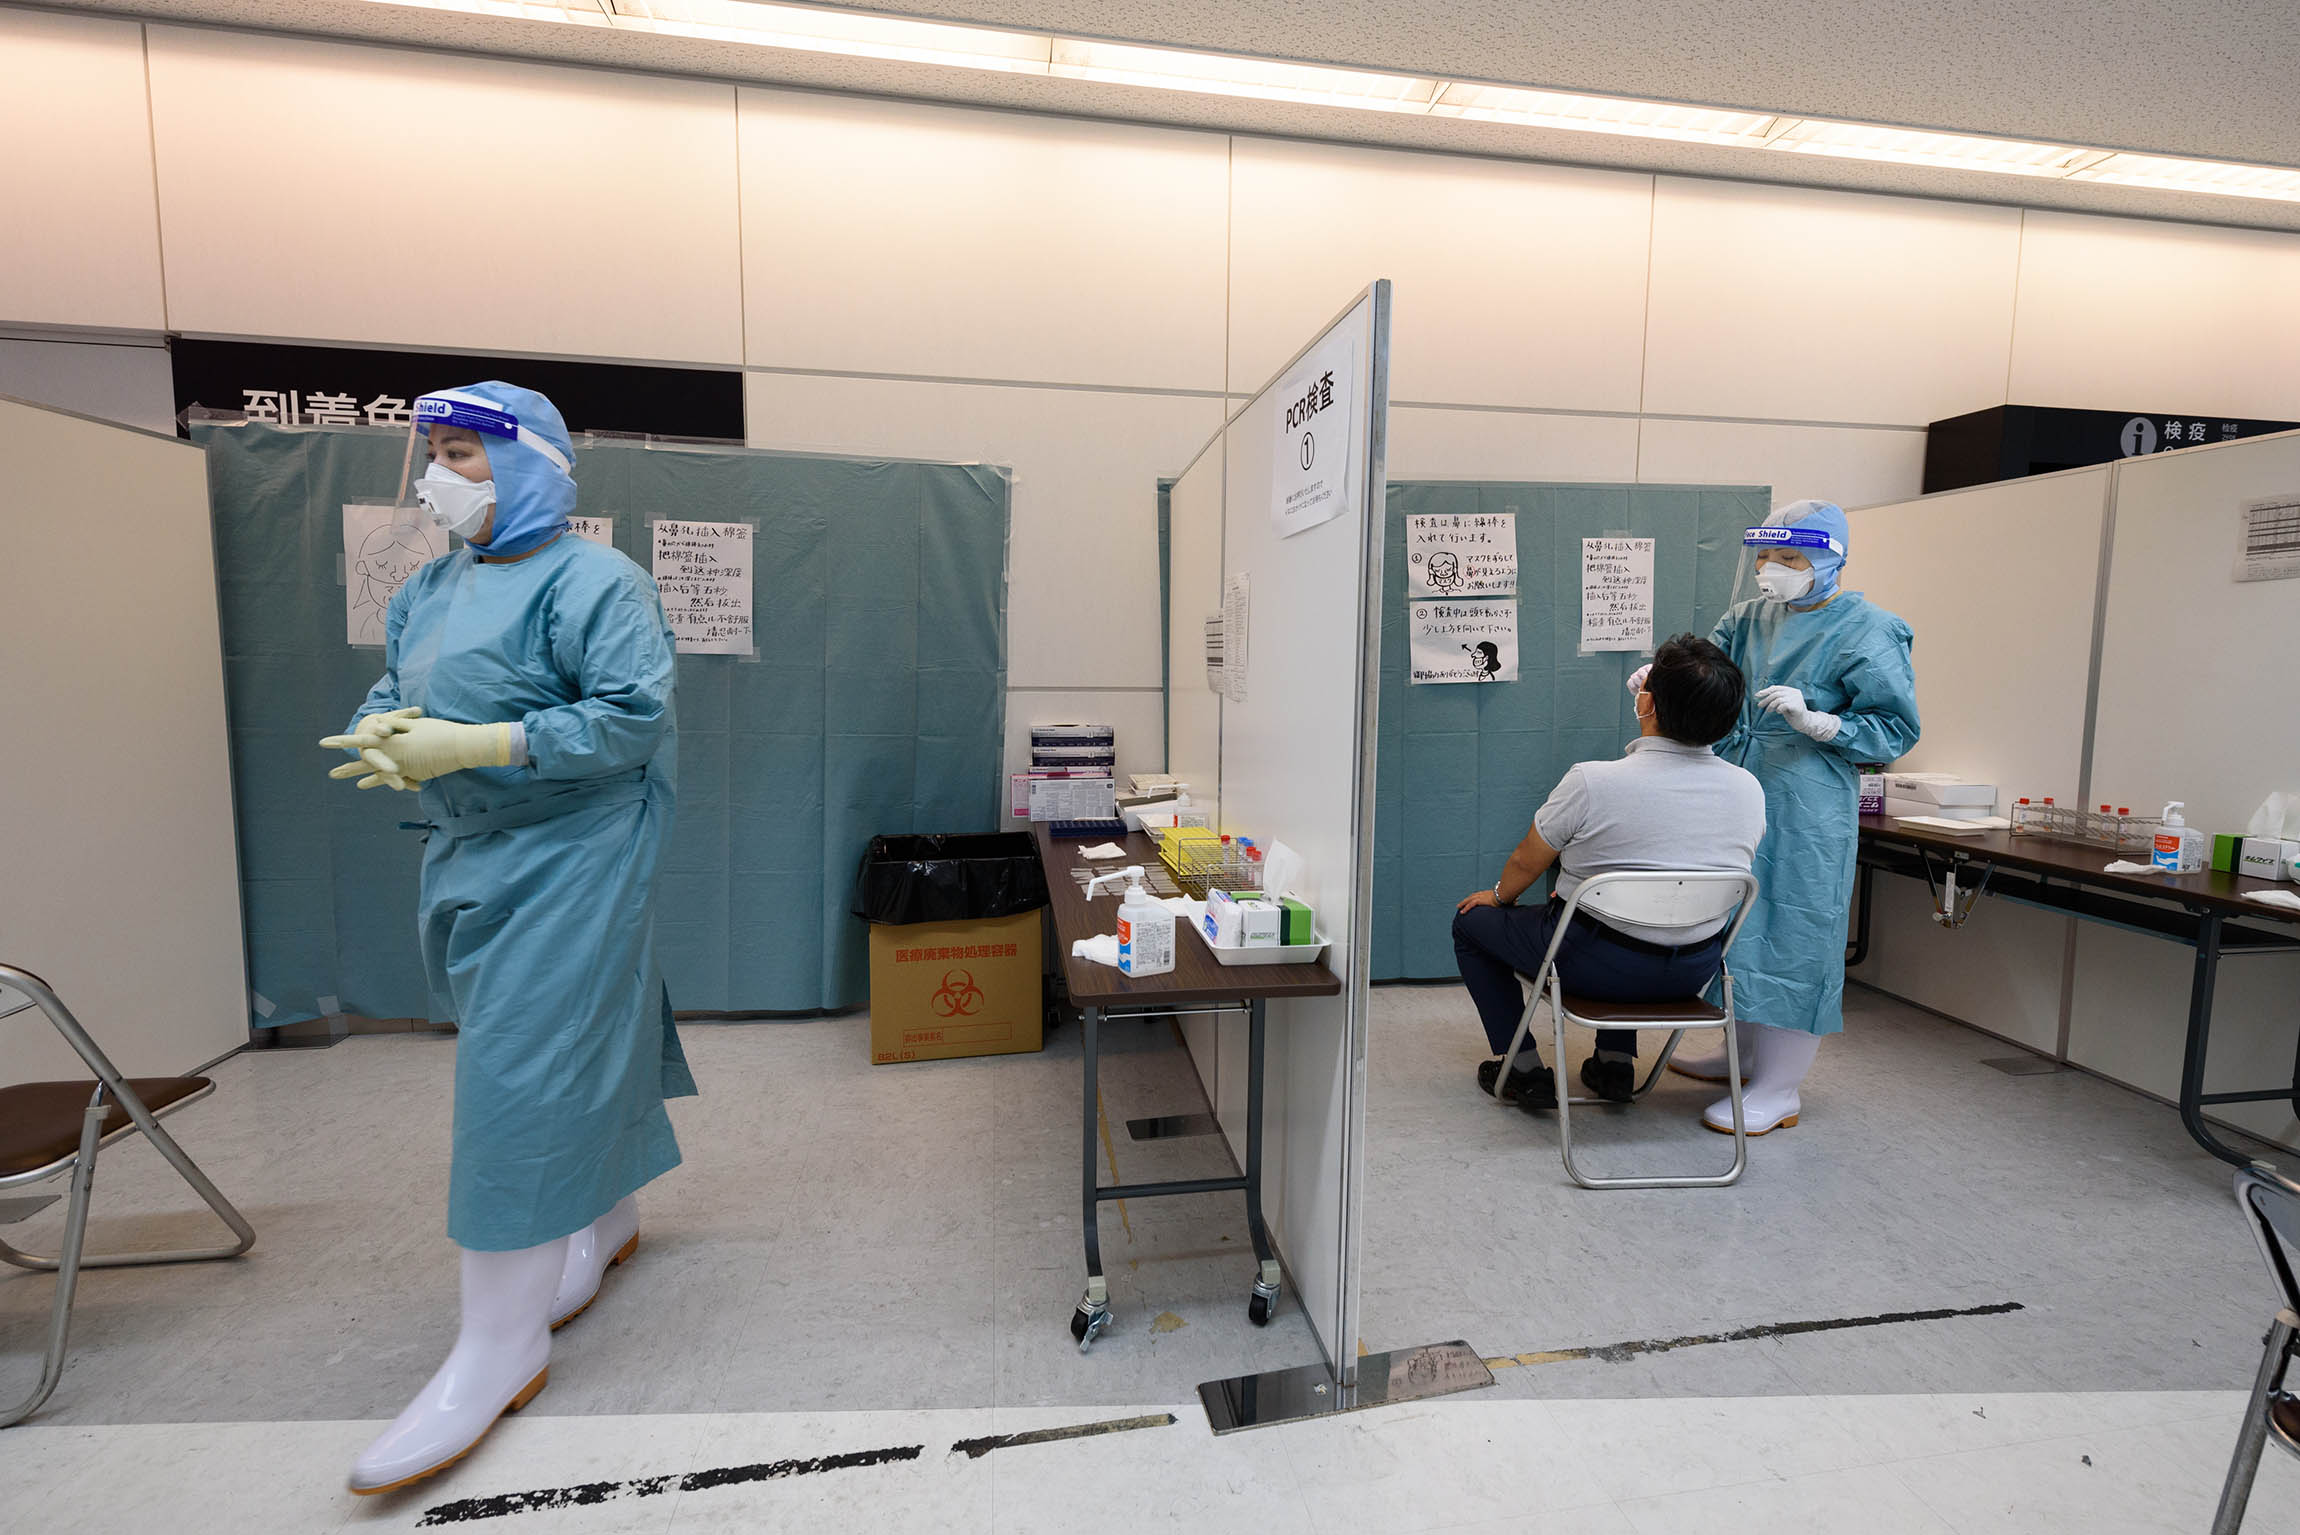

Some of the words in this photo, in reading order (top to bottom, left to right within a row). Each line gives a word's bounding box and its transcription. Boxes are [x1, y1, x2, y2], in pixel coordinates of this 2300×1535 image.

[1286, 370, 1334, 434] PCR検査
[2164, 421, 2206, 441] 検疫
[1416, 532, 1492, 544] 入れて行います。
[1758, 530, 1788, 539] Shield
[896, 943, 1017, 963] 医療廃棄物処理容器
